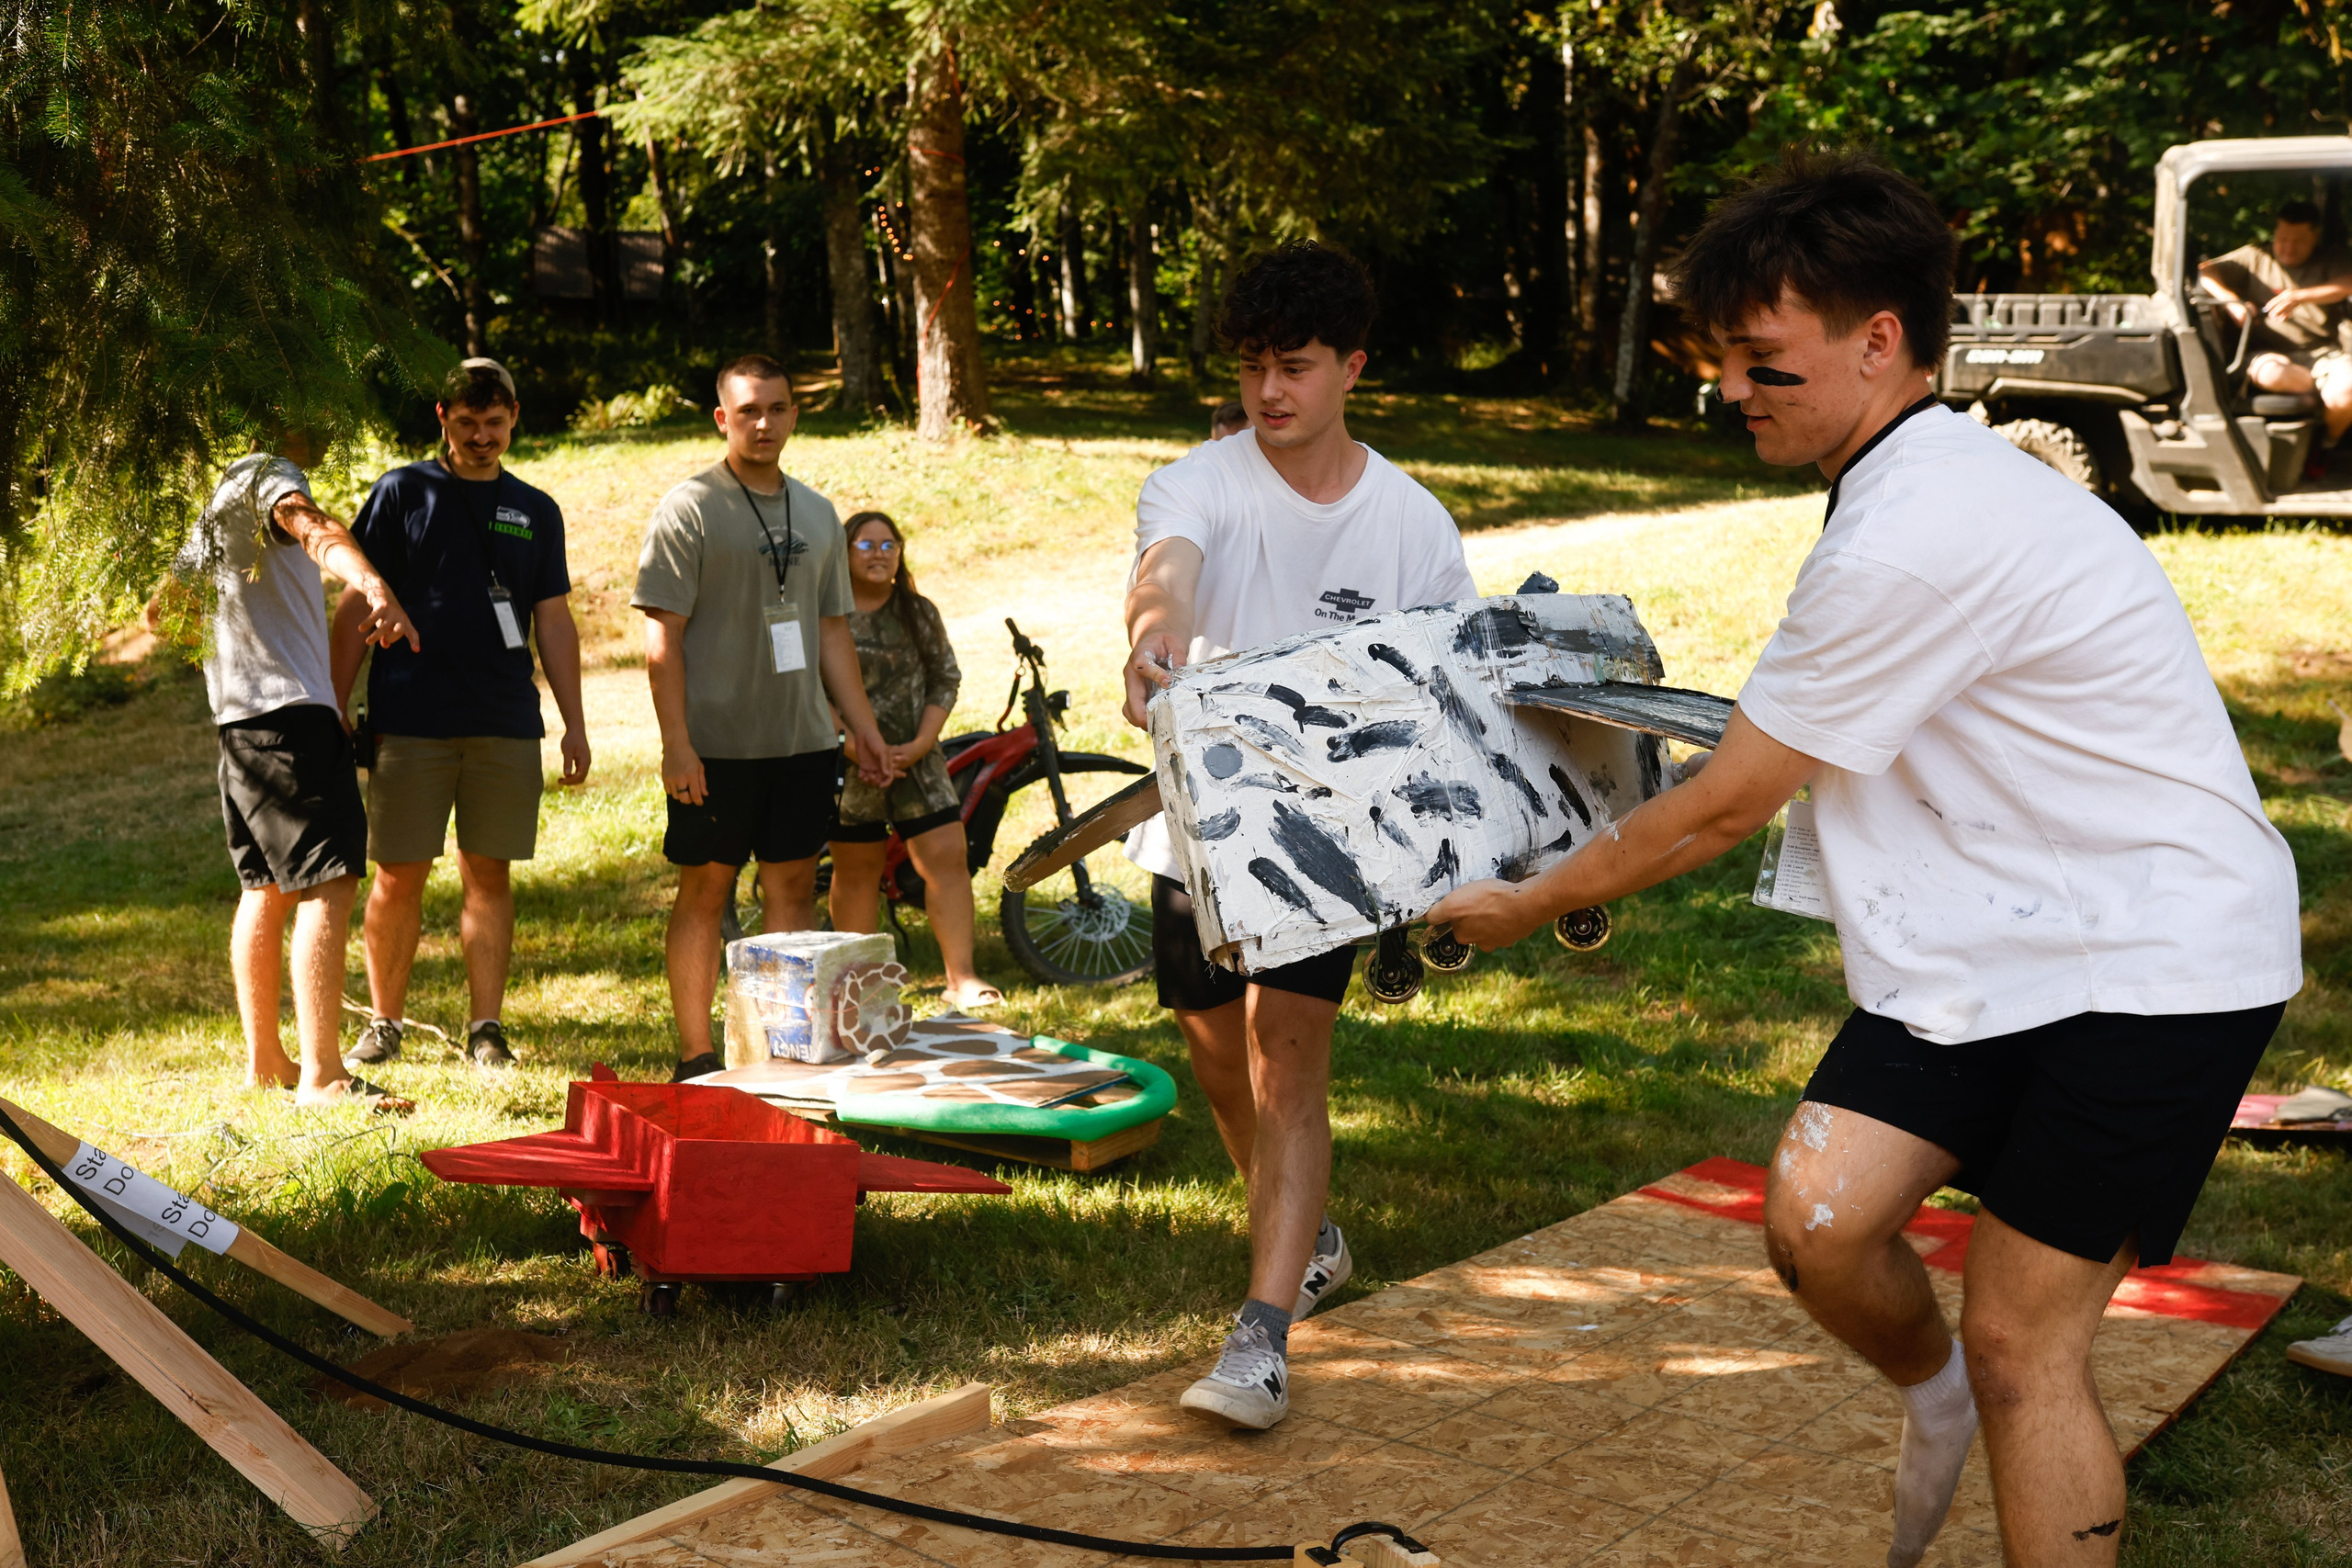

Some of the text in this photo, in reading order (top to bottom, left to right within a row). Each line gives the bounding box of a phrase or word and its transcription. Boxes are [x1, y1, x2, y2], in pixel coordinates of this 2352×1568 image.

[1325, 594, 1370, 606] CHEVROLET
[1315, 608, 1328, 618] On
[1329, 611, 1345, 622] The
[103, 1166, 134, 1196] Do
[187, 1210, 216, 1238] Do
[1305, 1270, 1329, 1296] N
[1263, 1371, 1282, 1402] N
